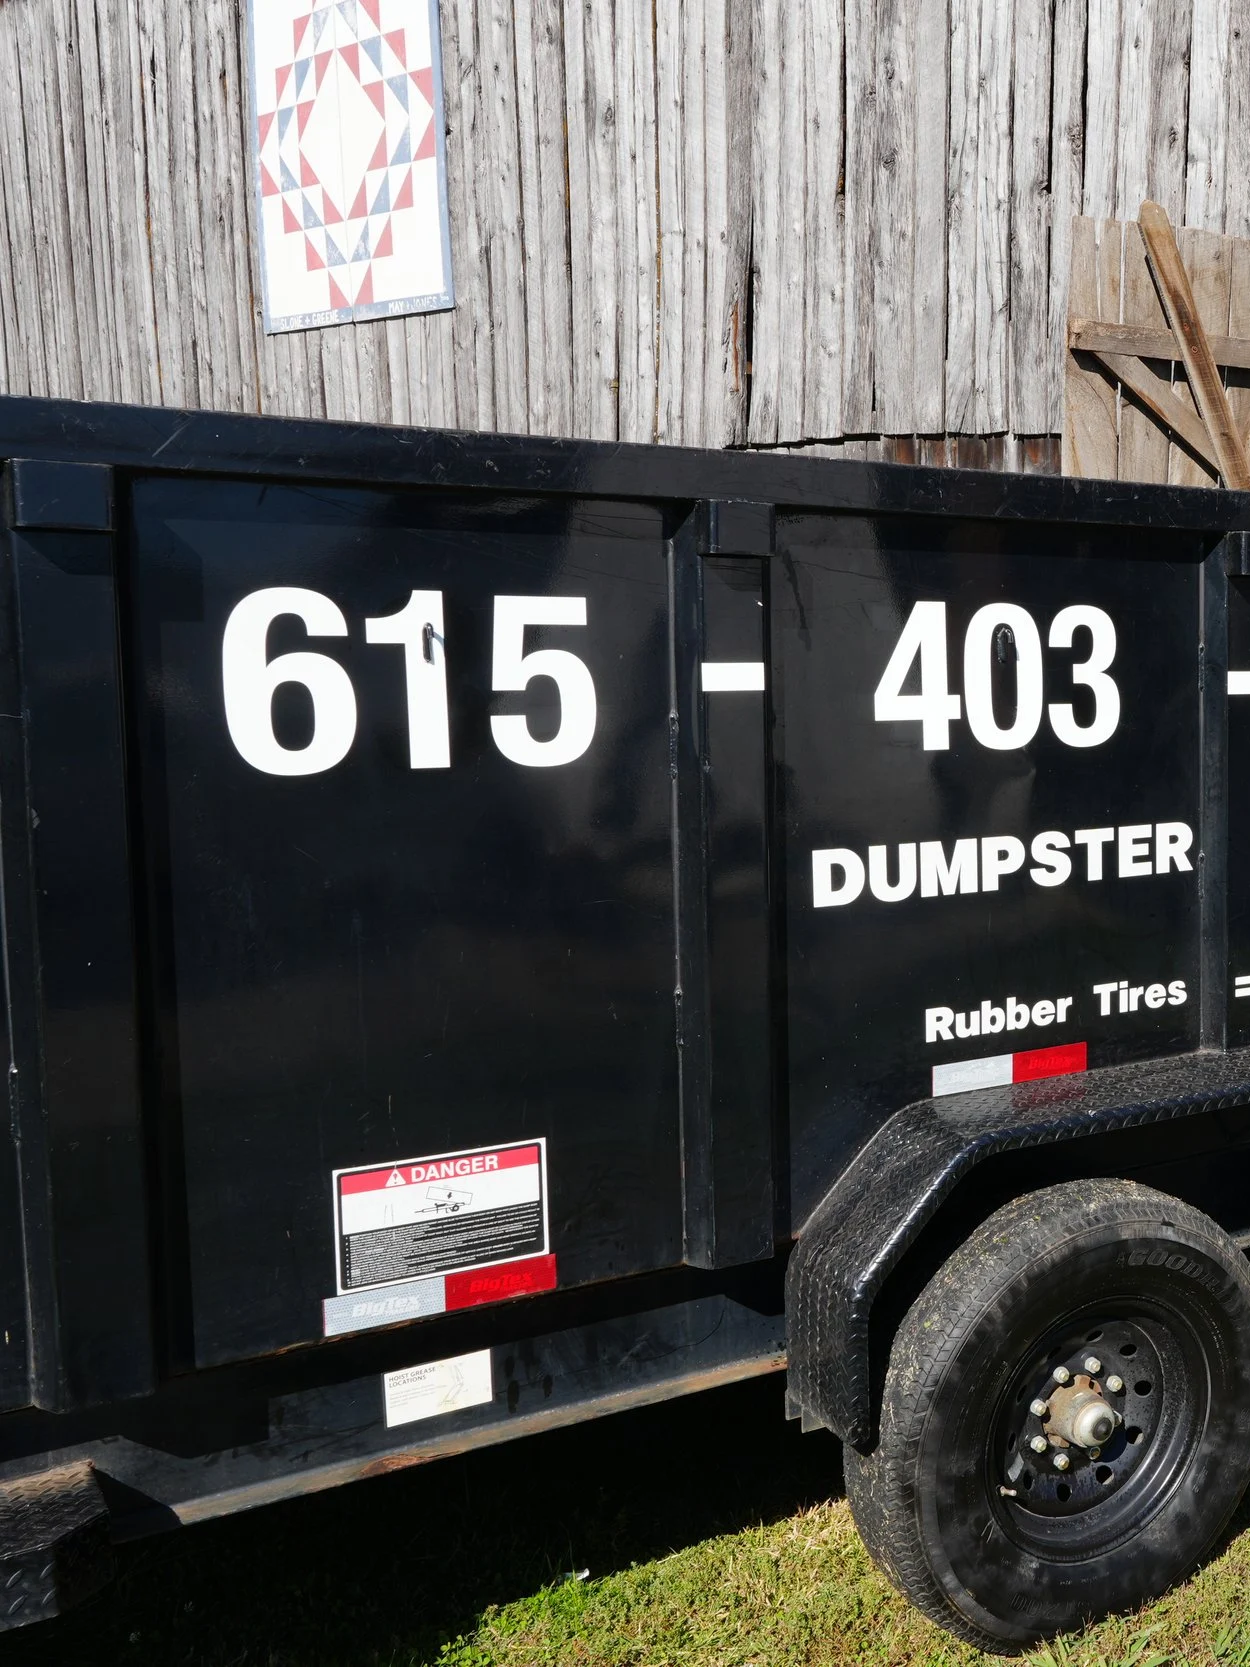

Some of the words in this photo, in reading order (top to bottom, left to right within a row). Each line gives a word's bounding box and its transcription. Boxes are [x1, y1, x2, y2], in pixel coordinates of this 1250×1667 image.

[312, 310, 340, 325] GREENE
[222, 587, 598, 777] 615
[873, 601, 1121, 751] 403
[812, 822, 1194, 908] DUMPSTER
[926, 993, 1073, 1044] Rubber
[1093, 980, 1188, 1017] Tires
[411, 1155, 499, 1183] DANGER
[388, 1372, 409, 1383] HOIST
[410, 1366, 436, 1378] GREASE
[389, 1374, 427, 1388] LOCATIONS
